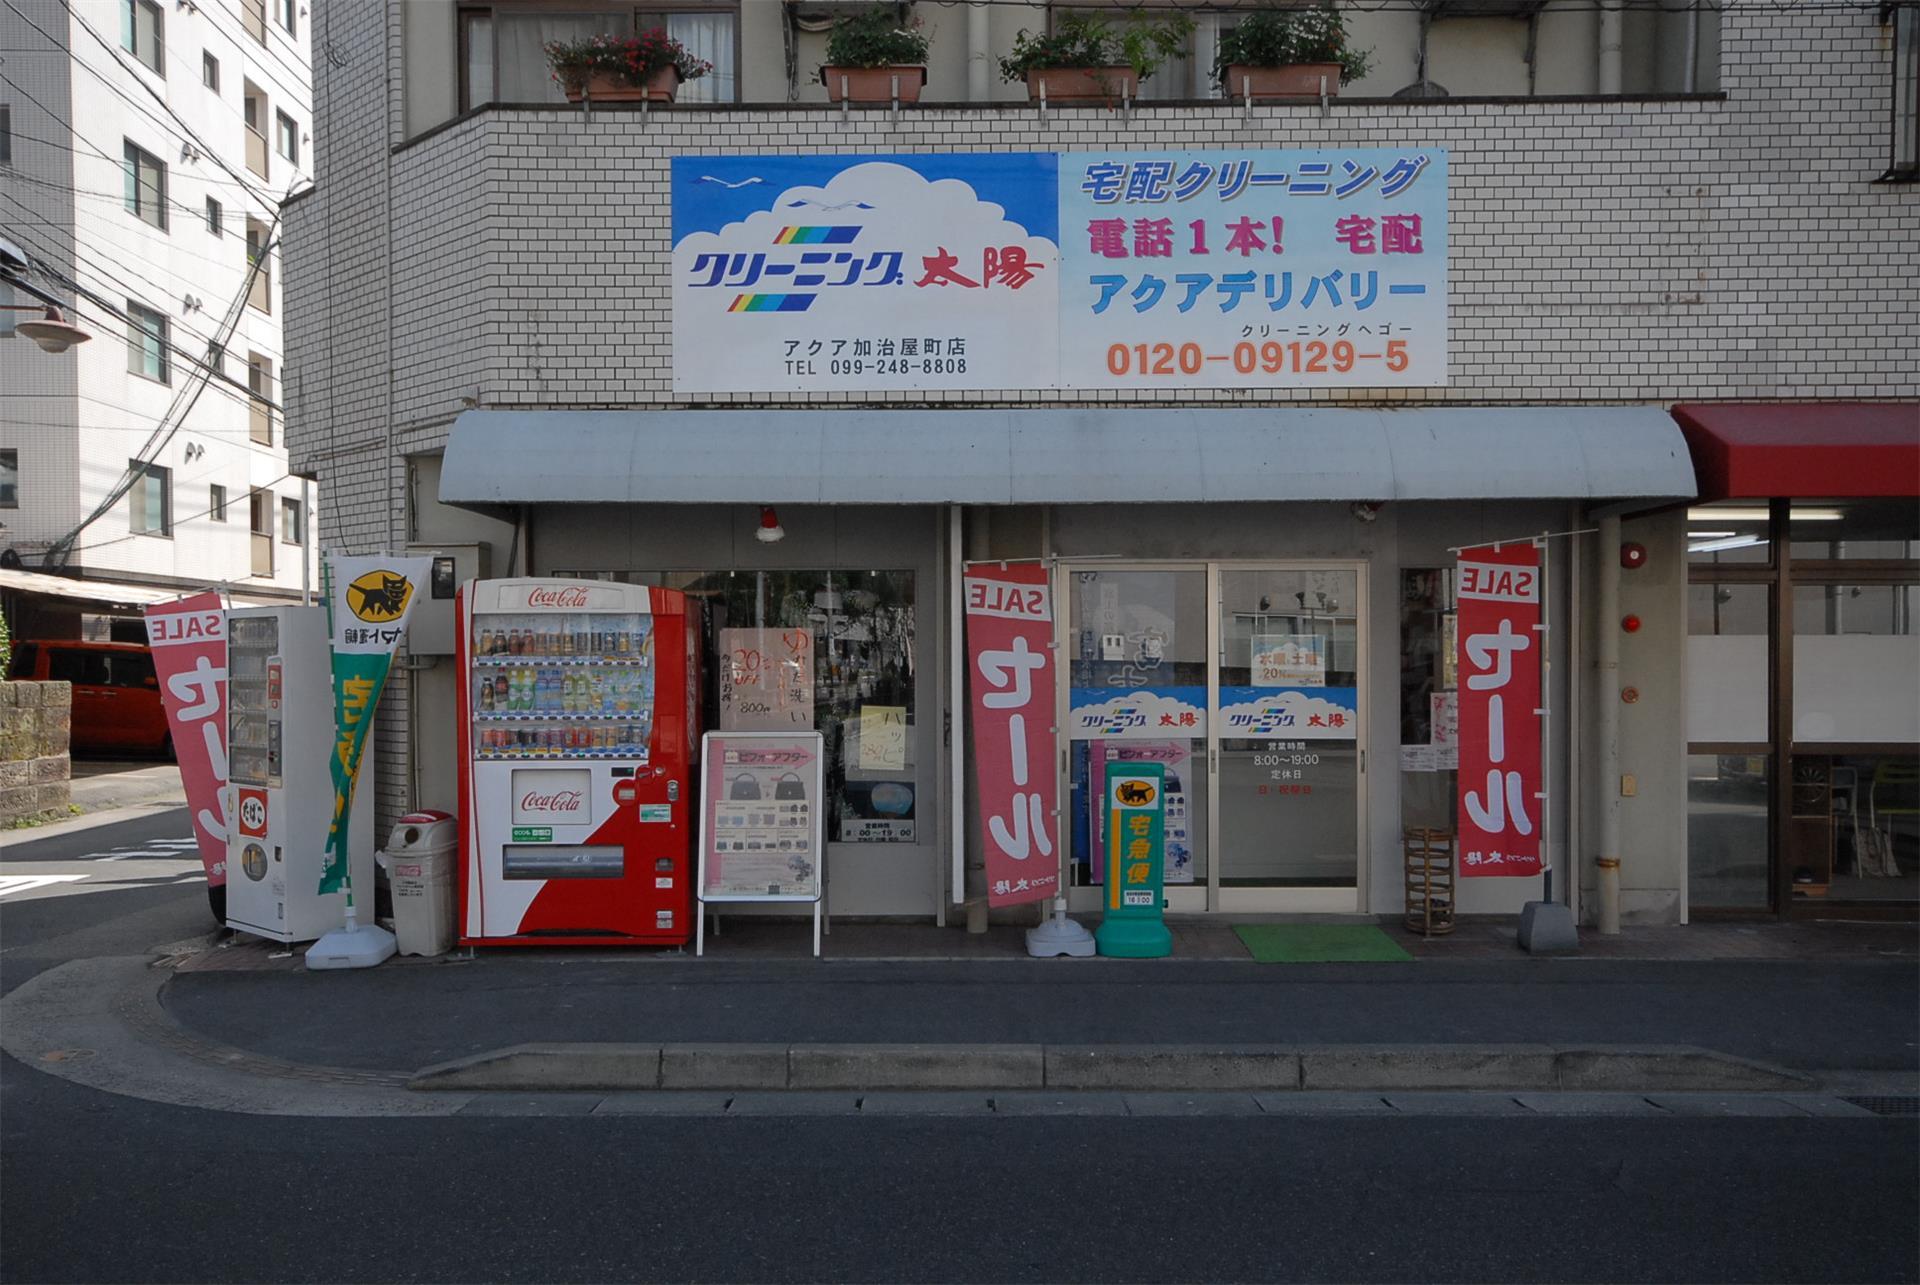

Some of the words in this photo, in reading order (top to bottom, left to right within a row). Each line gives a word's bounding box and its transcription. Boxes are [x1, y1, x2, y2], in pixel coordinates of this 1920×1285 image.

[1080, 154, 1431, 204] 宅配クリーニング
[1335, 212, 1425, 256] 宅配
[688, 251, 904, 288] クリーニング
[913, 246, 1045, 290] 太陽
[1089, 269, 1427, 315] アクアデリバリー
[784, 338, 967, 357] アクア加治屋町店
[1106, 339, 1410, 376] 0120-09129-5
[785, 360, 817, 376] TEL
[830, 358, 968, 375] 099-248-8808
[1081, 714, 1148, 729] クリーニング
[1157, 712, 1199, 728] 太陽
[1229, 714, 1296, 729] クリーニング
[1307, 712, 1349, 728] 太陽
[1268, 741, 1306, 751] 営業時間
[1271, 769, 1302, 780] 定休日
[242, 801, 264, 825] たばこ
[1127, 814, 1153, 885] 宅急便
